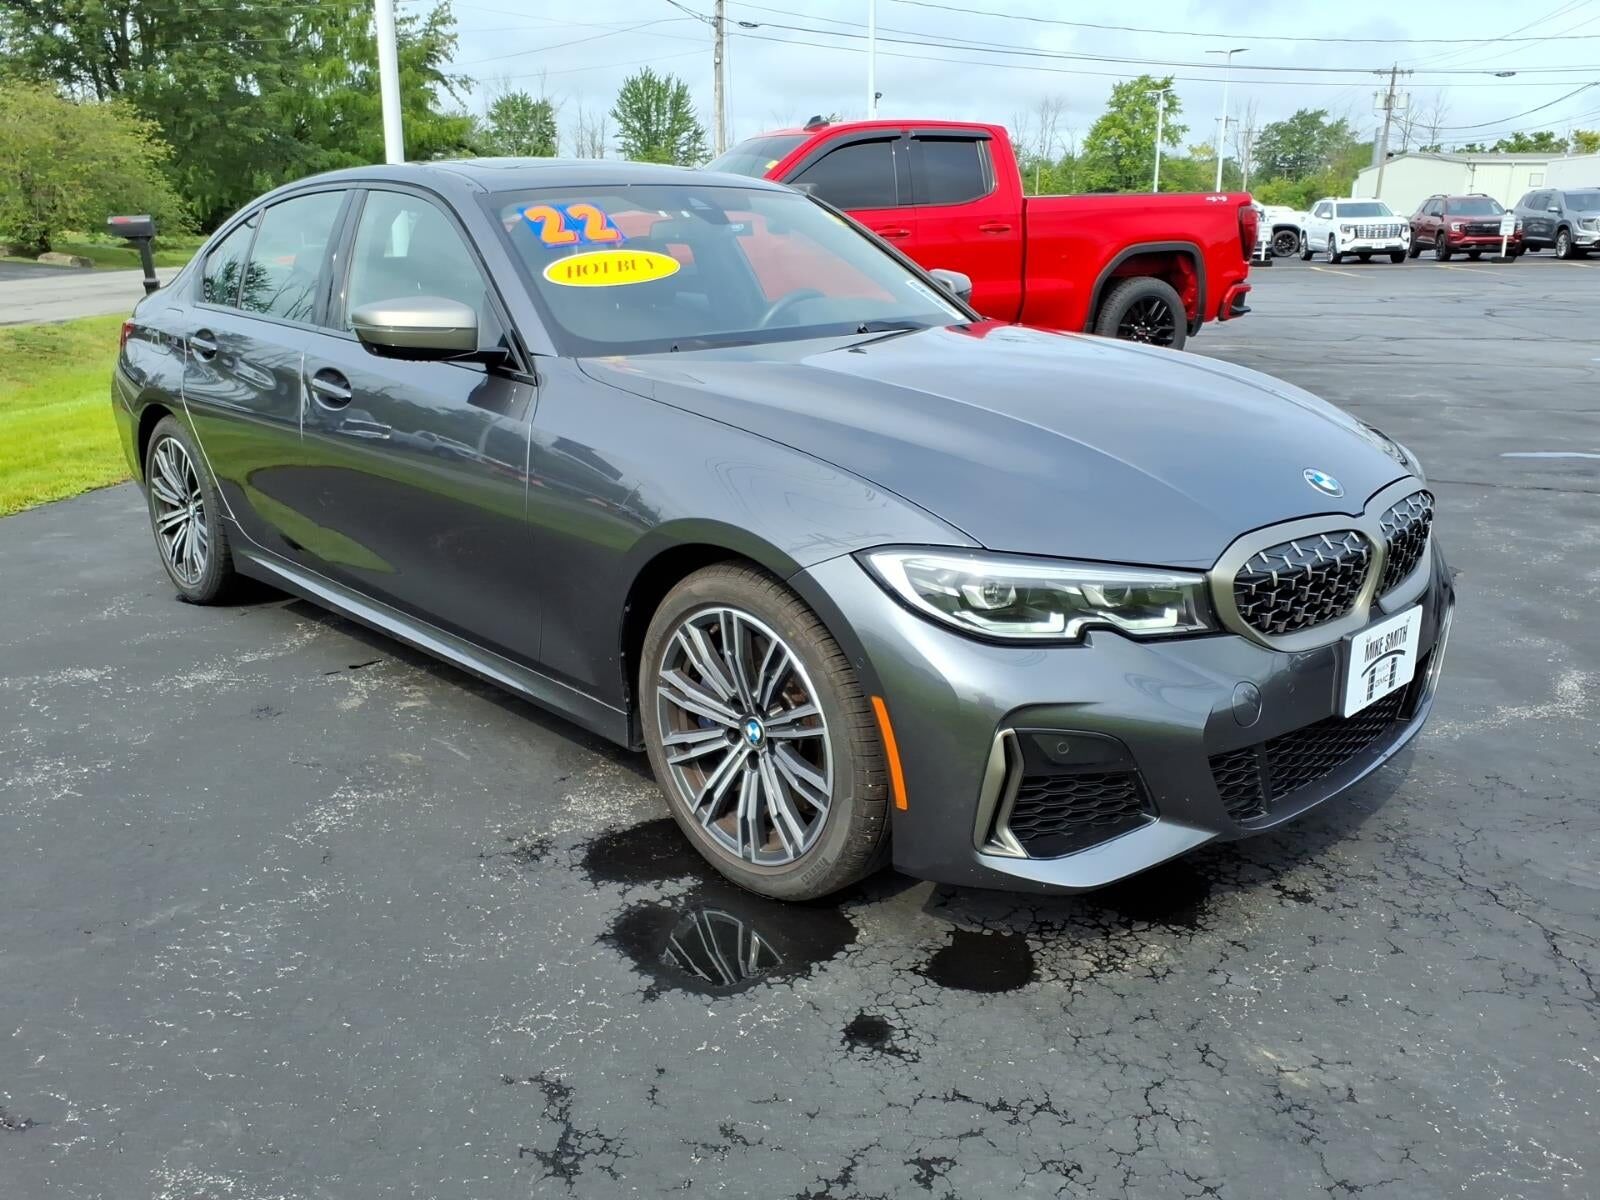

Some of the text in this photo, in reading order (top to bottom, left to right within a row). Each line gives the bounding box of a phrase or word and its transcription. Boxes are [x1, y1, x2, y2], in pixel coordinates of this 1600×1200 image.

[524, 203, 621, 243] 22
[566, 258, 655, 279] HOT BUY
[1364, 625, 1408, 663] MIKE SMITH
